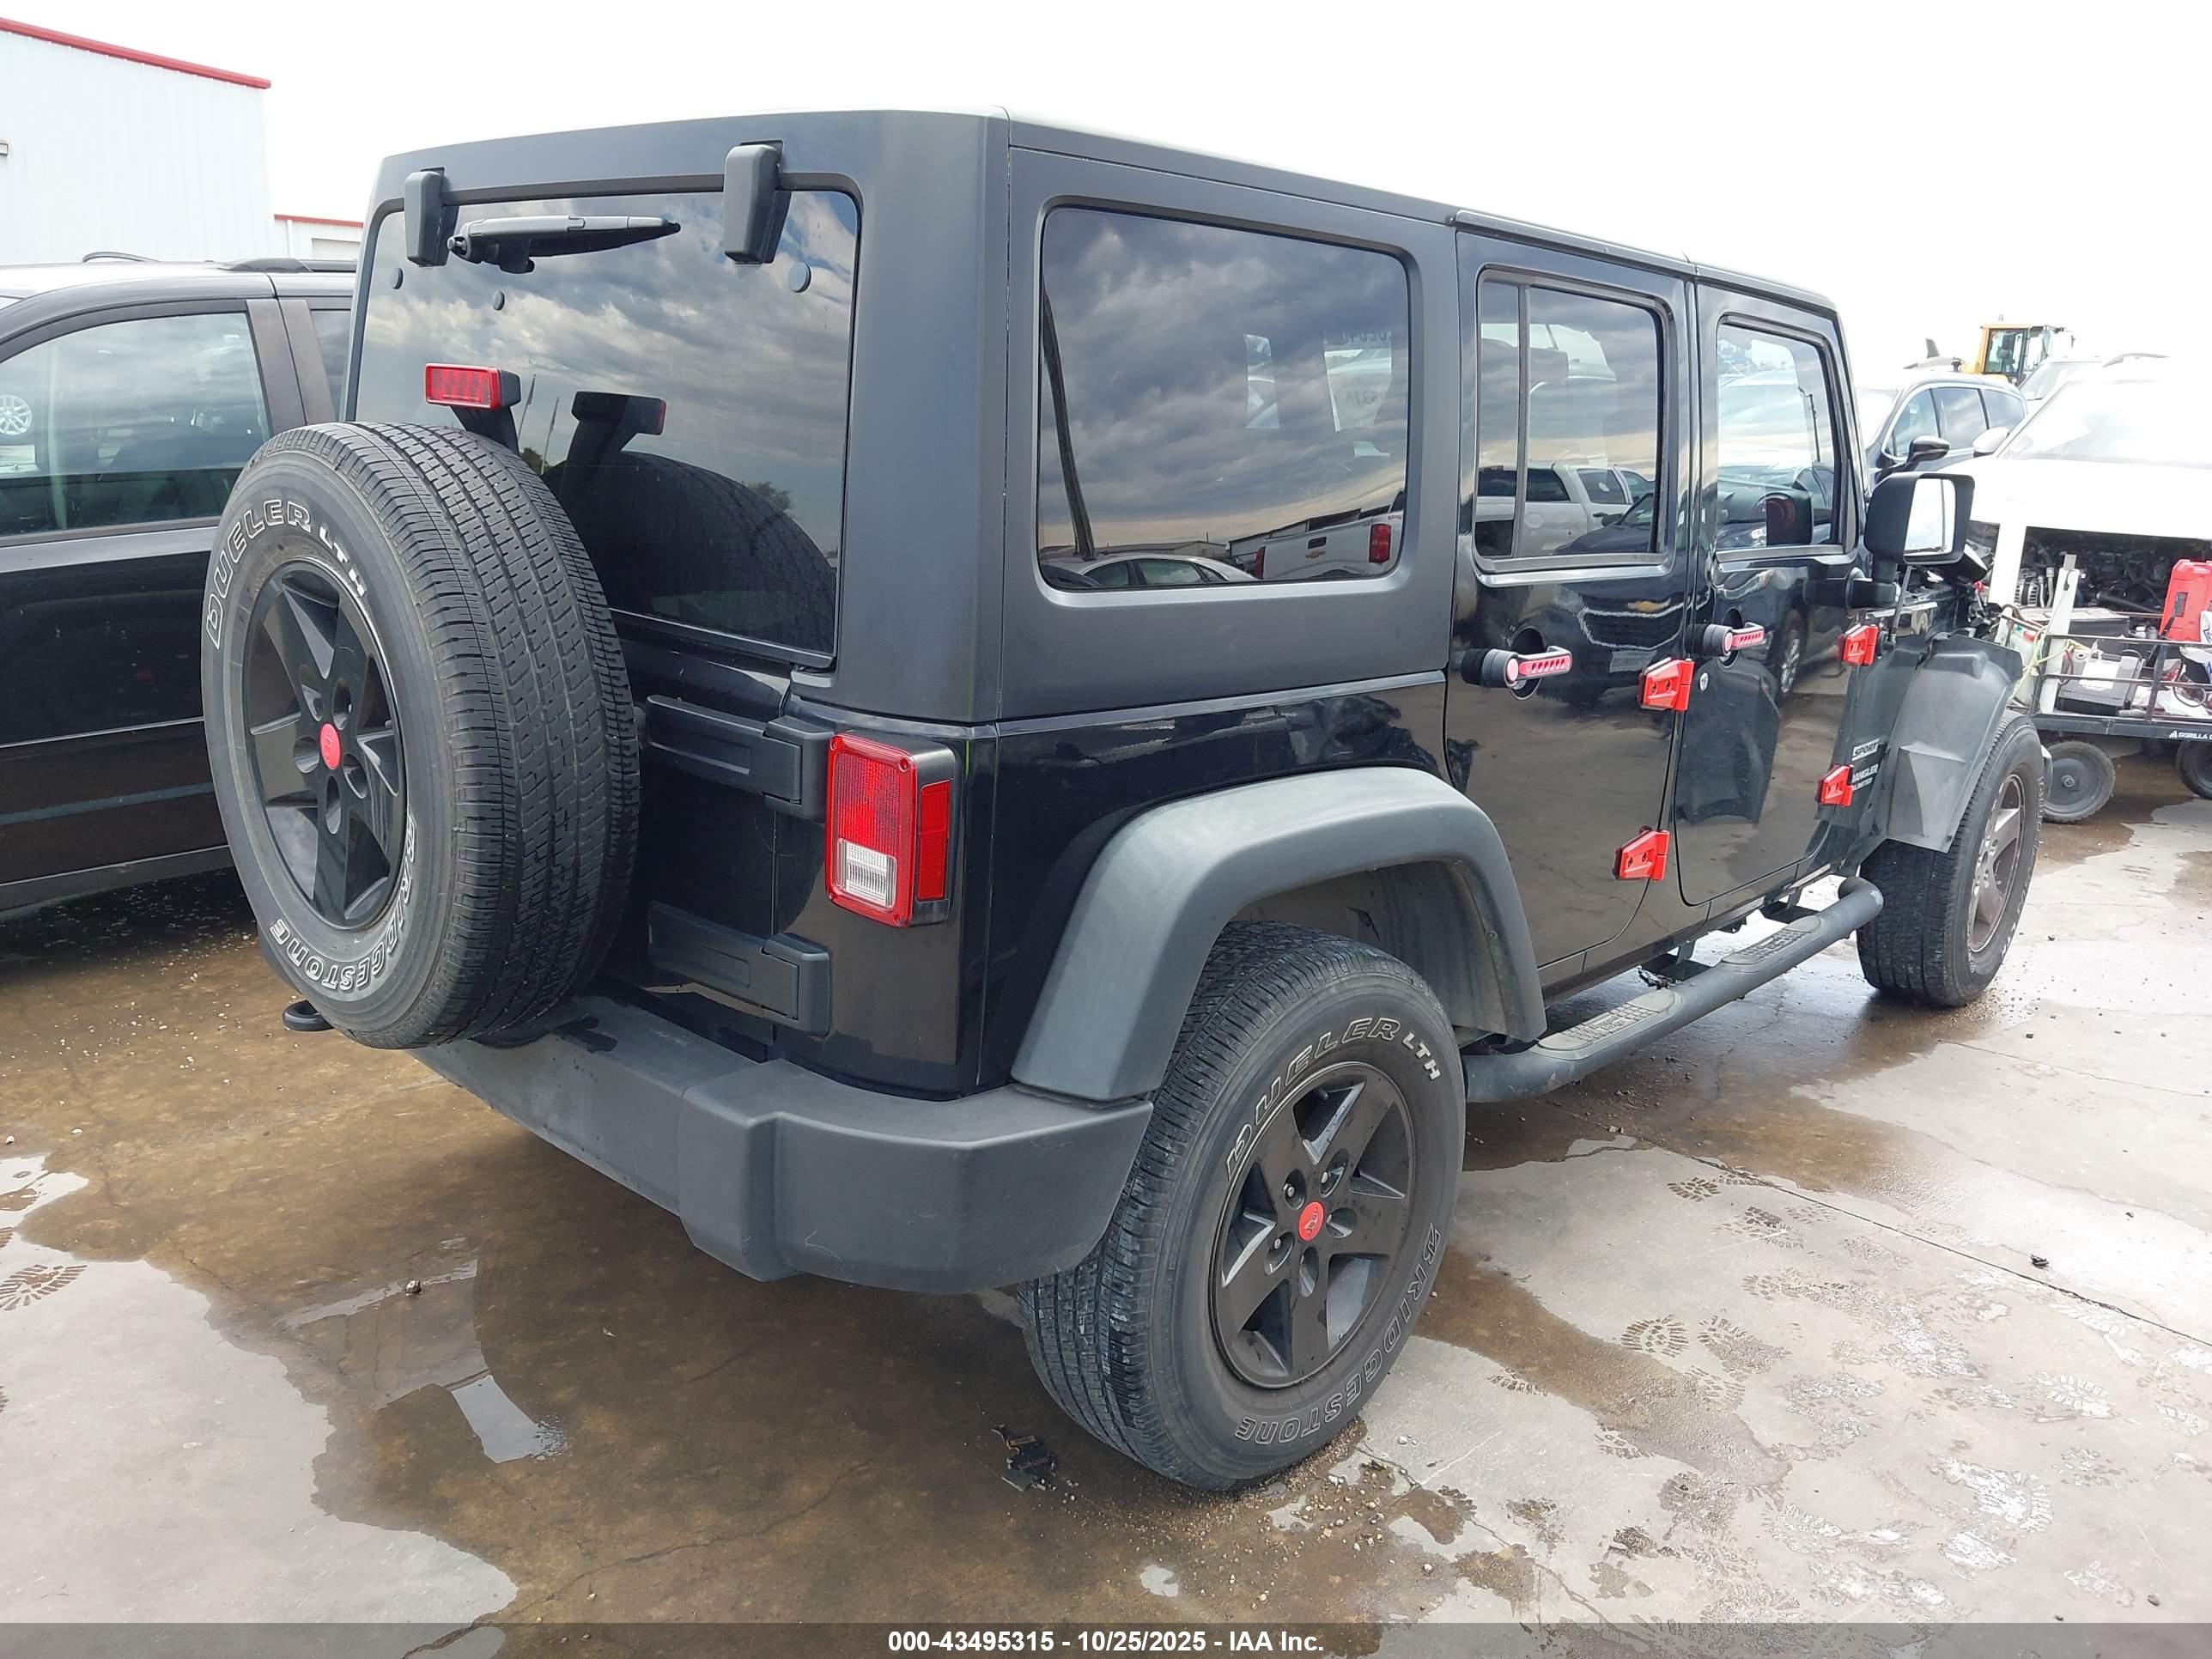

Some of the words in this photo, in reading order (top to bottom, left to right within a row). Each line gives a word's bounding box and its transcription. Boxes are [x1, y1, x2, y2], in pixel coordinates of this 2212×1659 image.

[205, 499, 312, 650] DUELER
[319, 526, 368, 597] LTH
[1852, 763, 1879, 783] ANGLER
[1853, 742, 1878, 757] SPORT
[1854, 777, 1873, 790] LIMITED
[269, 812, 416, 991] BRIDGESTONE
[1226, 1018, 1401, 1182] DUELER
[1402, 1032, 1441, 1080] LTH
[1235, 1223, 1442, 1444] BRIDGESTONE
